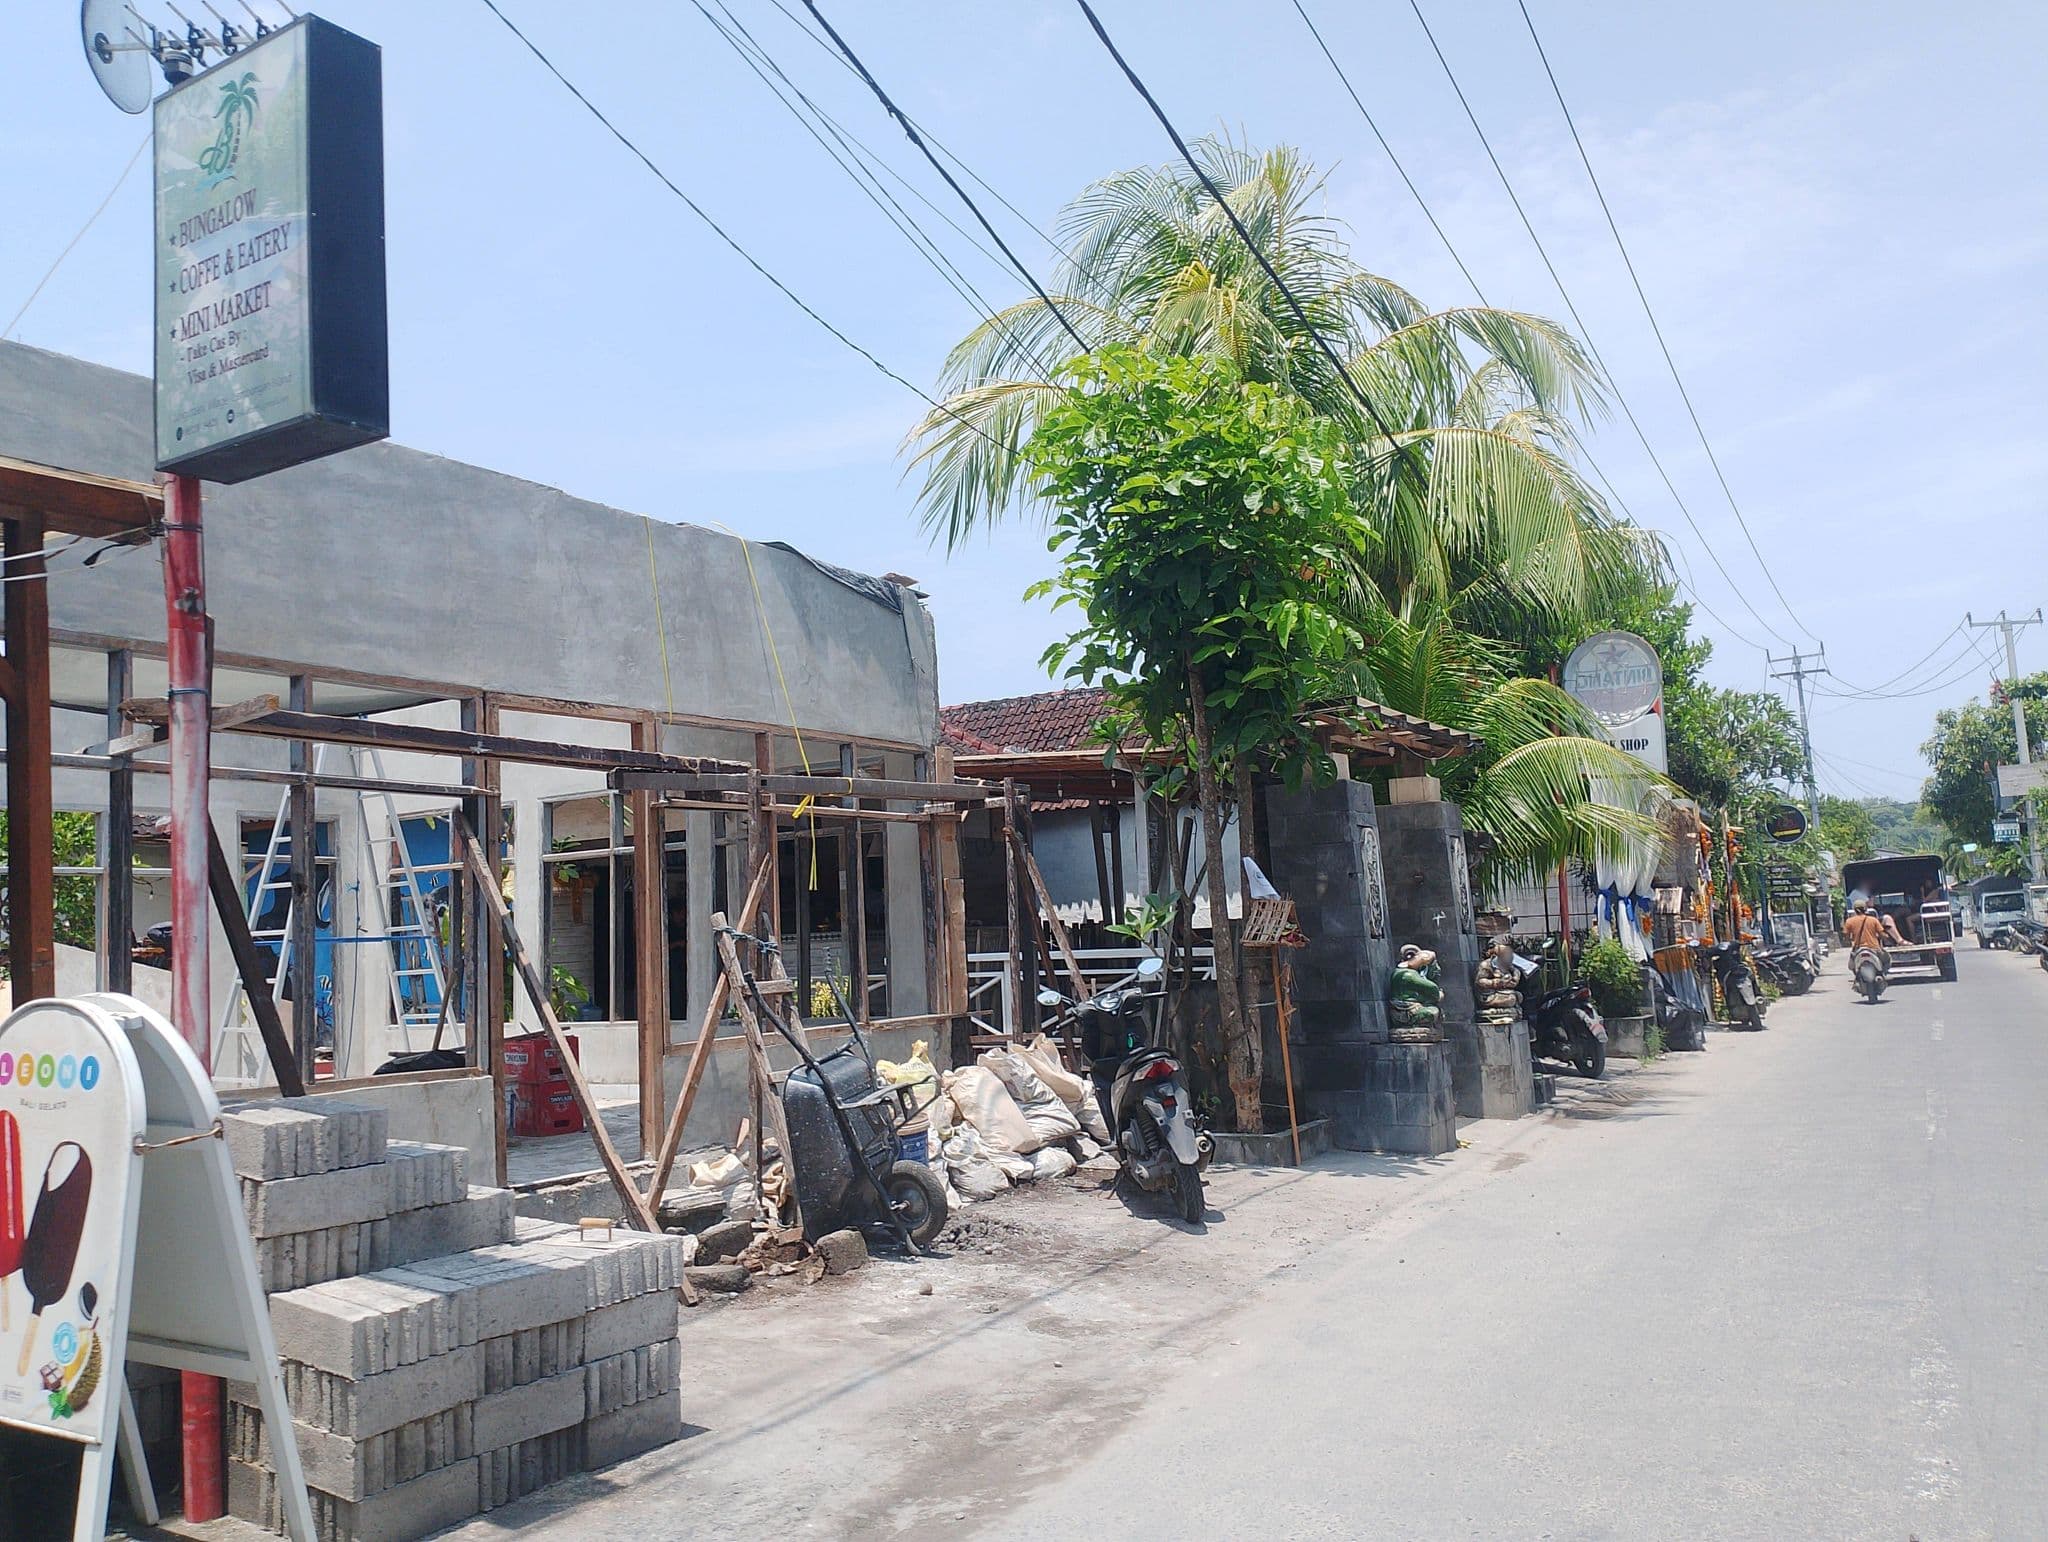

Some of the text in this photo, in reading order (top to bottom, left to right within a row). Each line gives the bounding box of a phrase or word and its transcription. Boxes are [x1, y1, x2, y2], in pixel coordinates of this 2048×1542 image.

[179, 187, 257, 249] BUNGALOW
[180, 221, 292, 294] COFFE & EATERY
[180, 280, 272, 342] MINI MARKET
[187, 344, 208, 363] Take
[187, 341, 269, 385] Visa & Mastercard
[1620, 738, 1649, 751] SHOP
